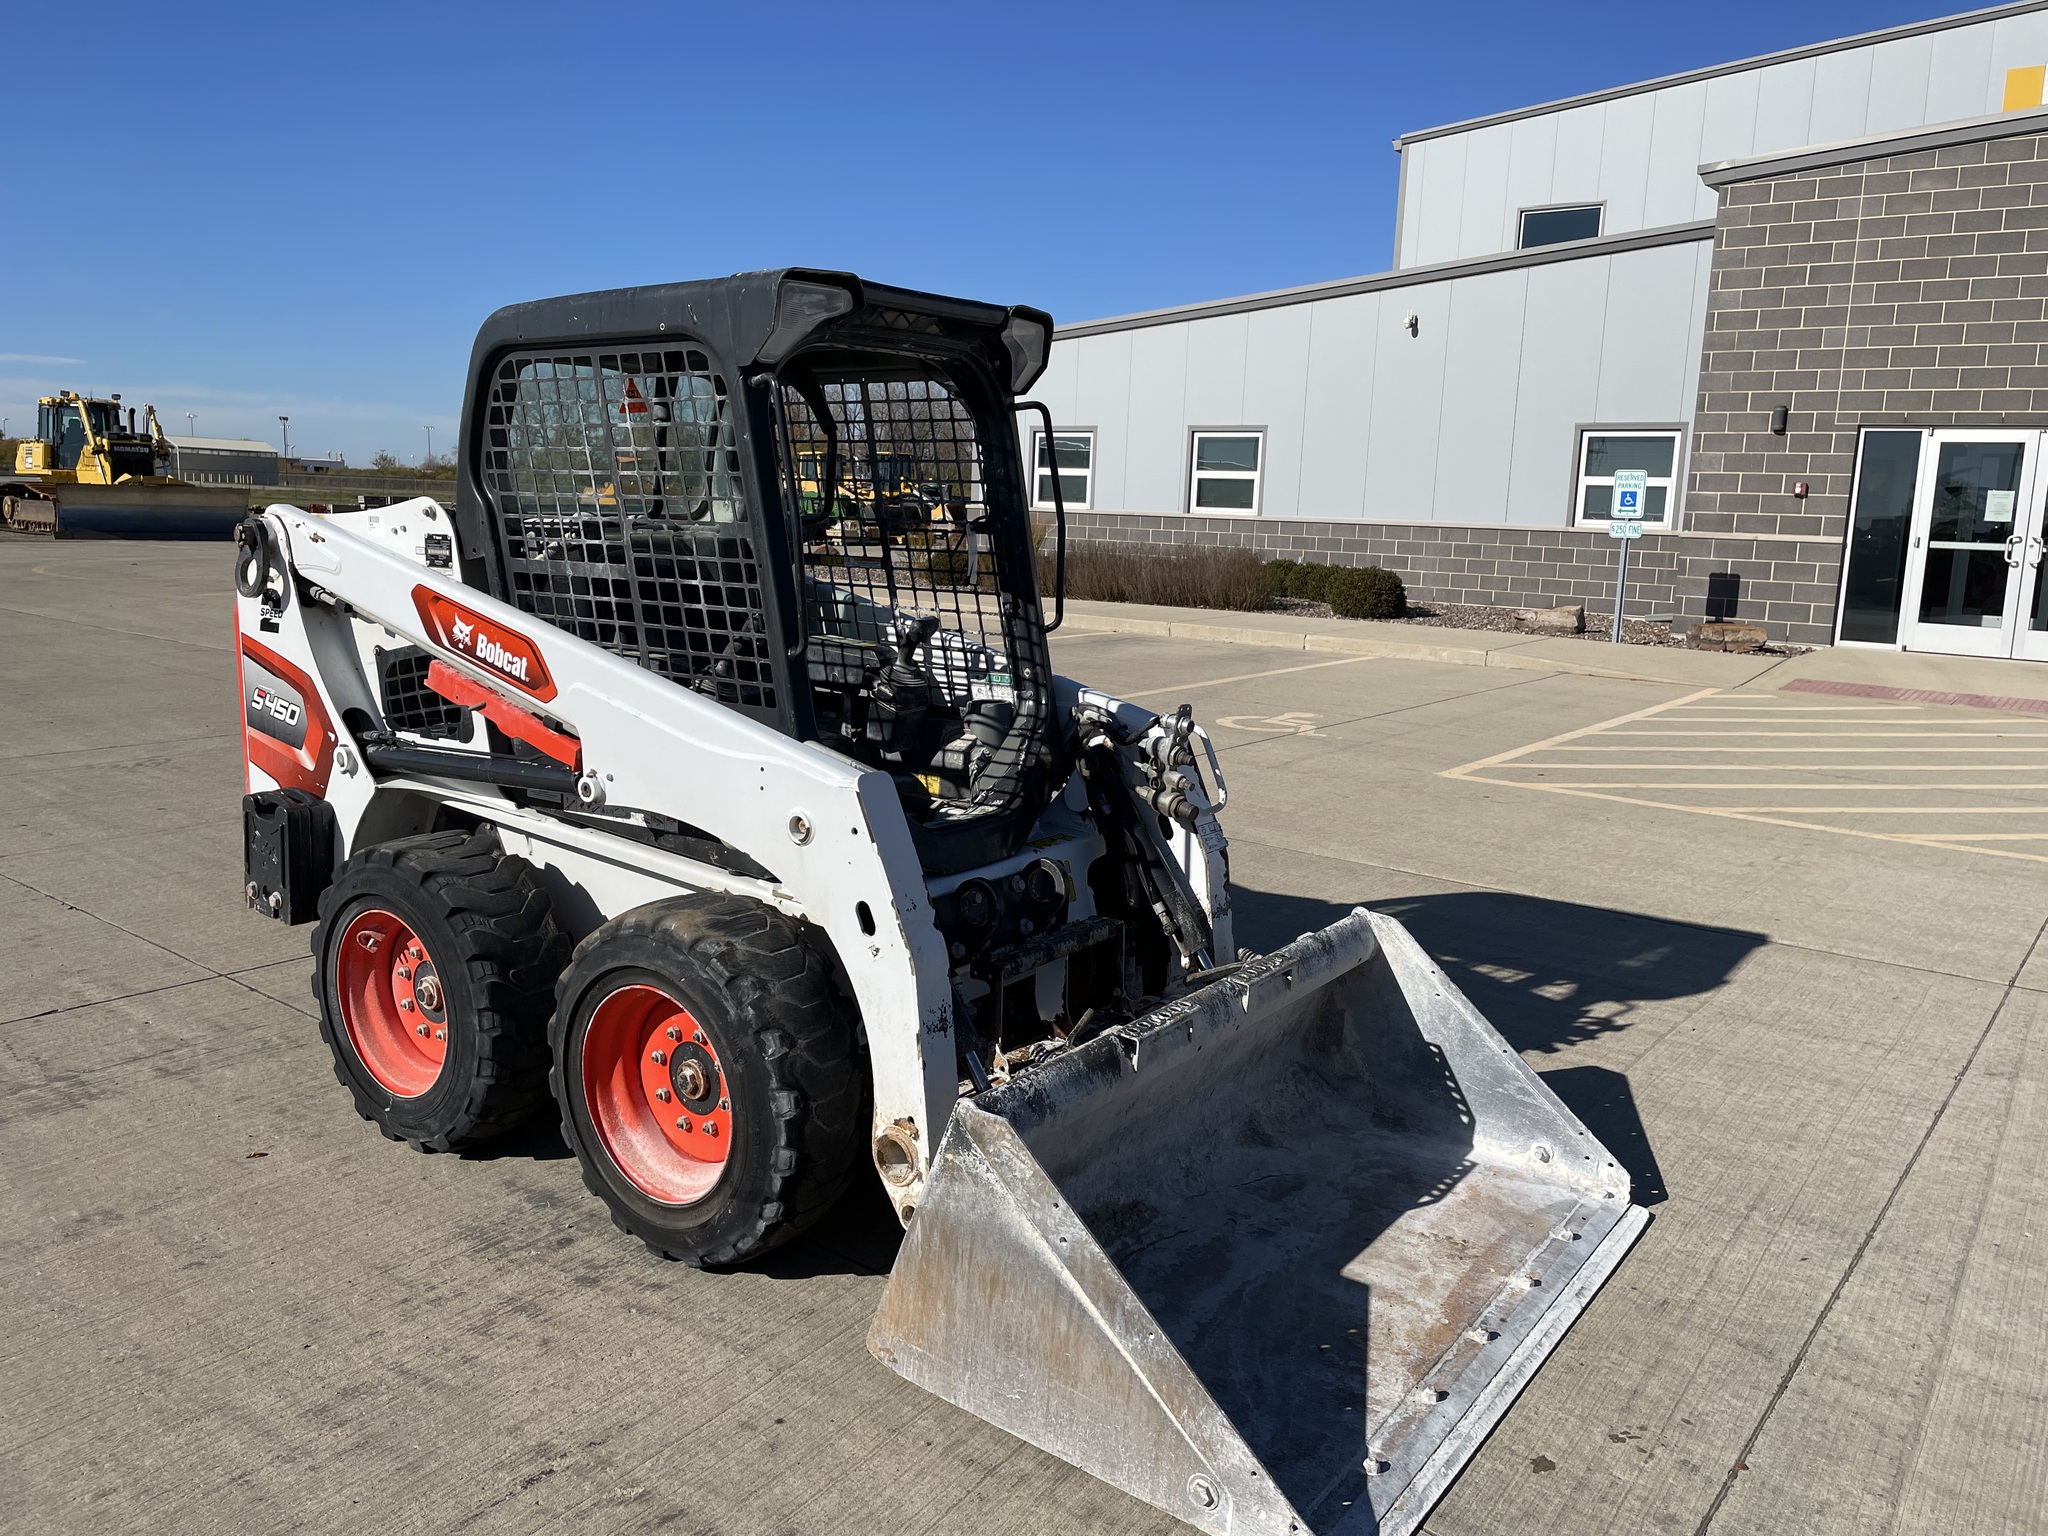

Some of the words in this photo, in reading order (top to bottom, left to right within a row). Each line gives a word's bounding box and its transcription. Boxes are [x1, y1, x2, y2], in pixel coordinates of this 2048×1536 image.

[114, 445, 150, 453] KOMATSU
[1611, 525, 1626, 535] $250
[1628, 525, 1640, 535] FINE
[260, 607, 283, 618] SPEED
[476, 632, 528, 681] Bobcat
[251, 686, 301, 727] S450
